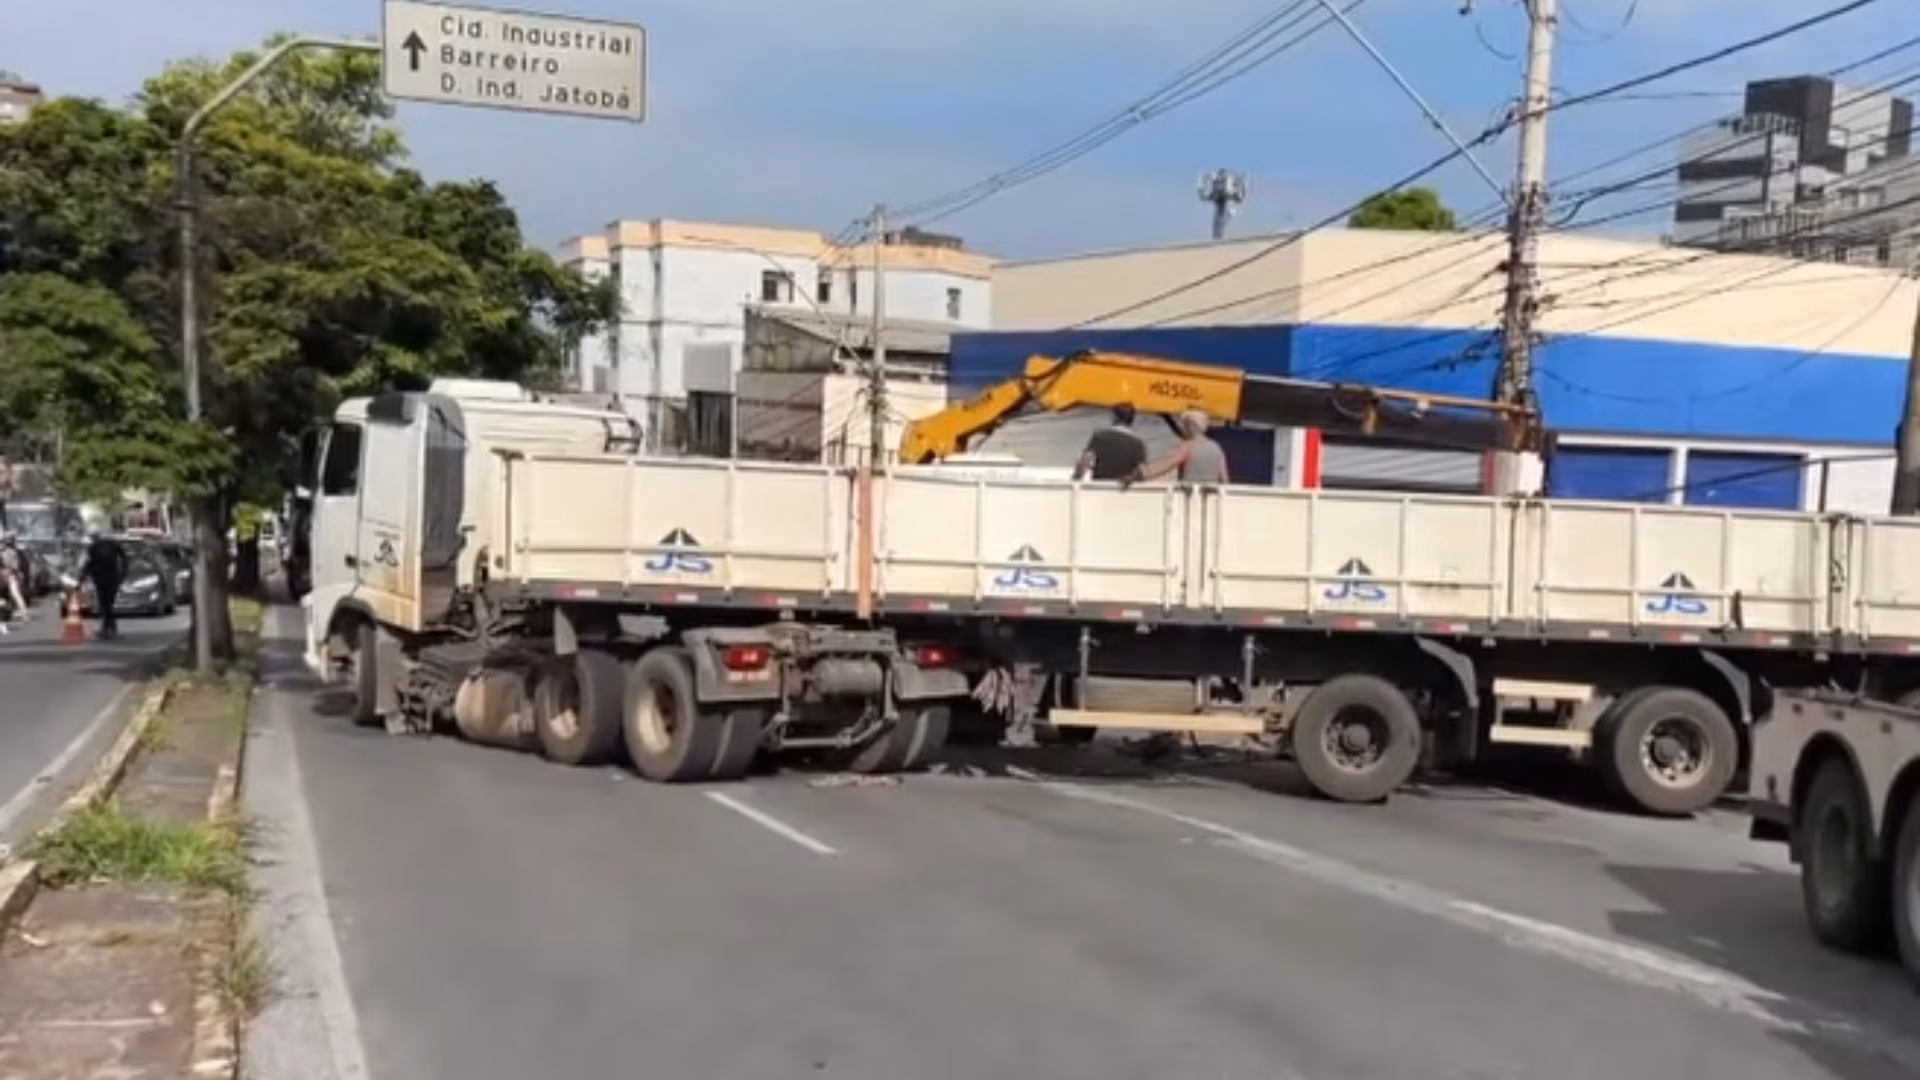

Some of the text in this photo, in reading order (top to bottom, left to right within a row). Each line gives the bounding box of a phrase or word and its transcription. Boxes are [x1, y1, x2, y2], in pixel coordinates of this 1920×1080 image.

[440, 15, 632, 55] Cid. Industrial
[440, 43, 559, 75] Barreiro
[440, 73, 630, 110] D. Ind. Jatobá
[645, 551, 712, 573] JS
[993, 565, 1059, 588] JS
[1323, 579, 1387, 602] JS
[1646, 592, 1709, 615] JS
